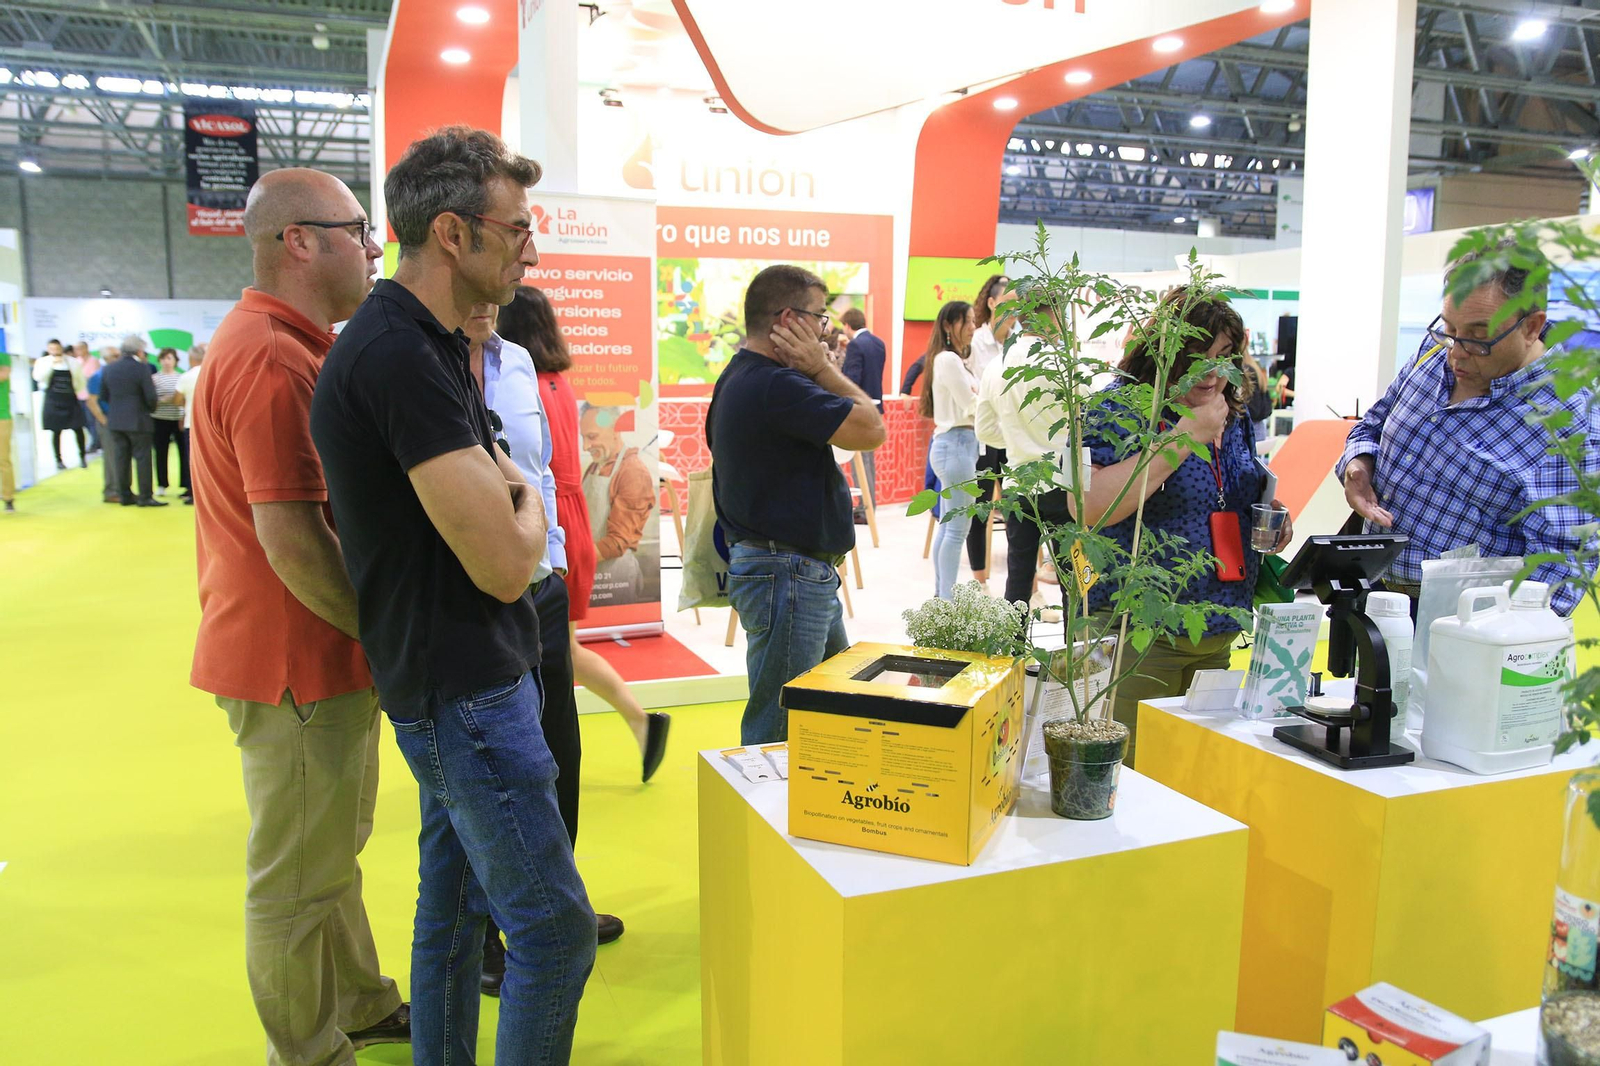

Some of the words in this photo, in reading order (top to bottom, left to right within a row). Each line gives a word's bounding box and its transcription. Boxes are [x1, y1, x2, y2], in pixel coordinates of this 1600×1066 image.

[192, 119, 249, 133] VICASOL
[680, 158, 815, 199] Unión
[557, 207, 577, 220] La
[557, 222, 608, 237] Unión
[685, 224, 731, 248] que
[738, 225, 781, 245] nos
[788, 228, 831, 247] une
[564, 268, 634, 281] servicio
[540, 286, 604, 301] eguros
[559, 324, 608, 336] ocios
[608, 363, 639, 373] futuro
[1291, 613, 1316, 622] PLANTA
[840, 790, 911, 813] Agrobío
[803, 809, 838, 821] Biopollination
[846, 817, 875, 827] vegetables,
[888, 823, 903, 832] crops
[915, 827, 949, 838] ornamentals
[861, 826, 888, 836] Bombus
